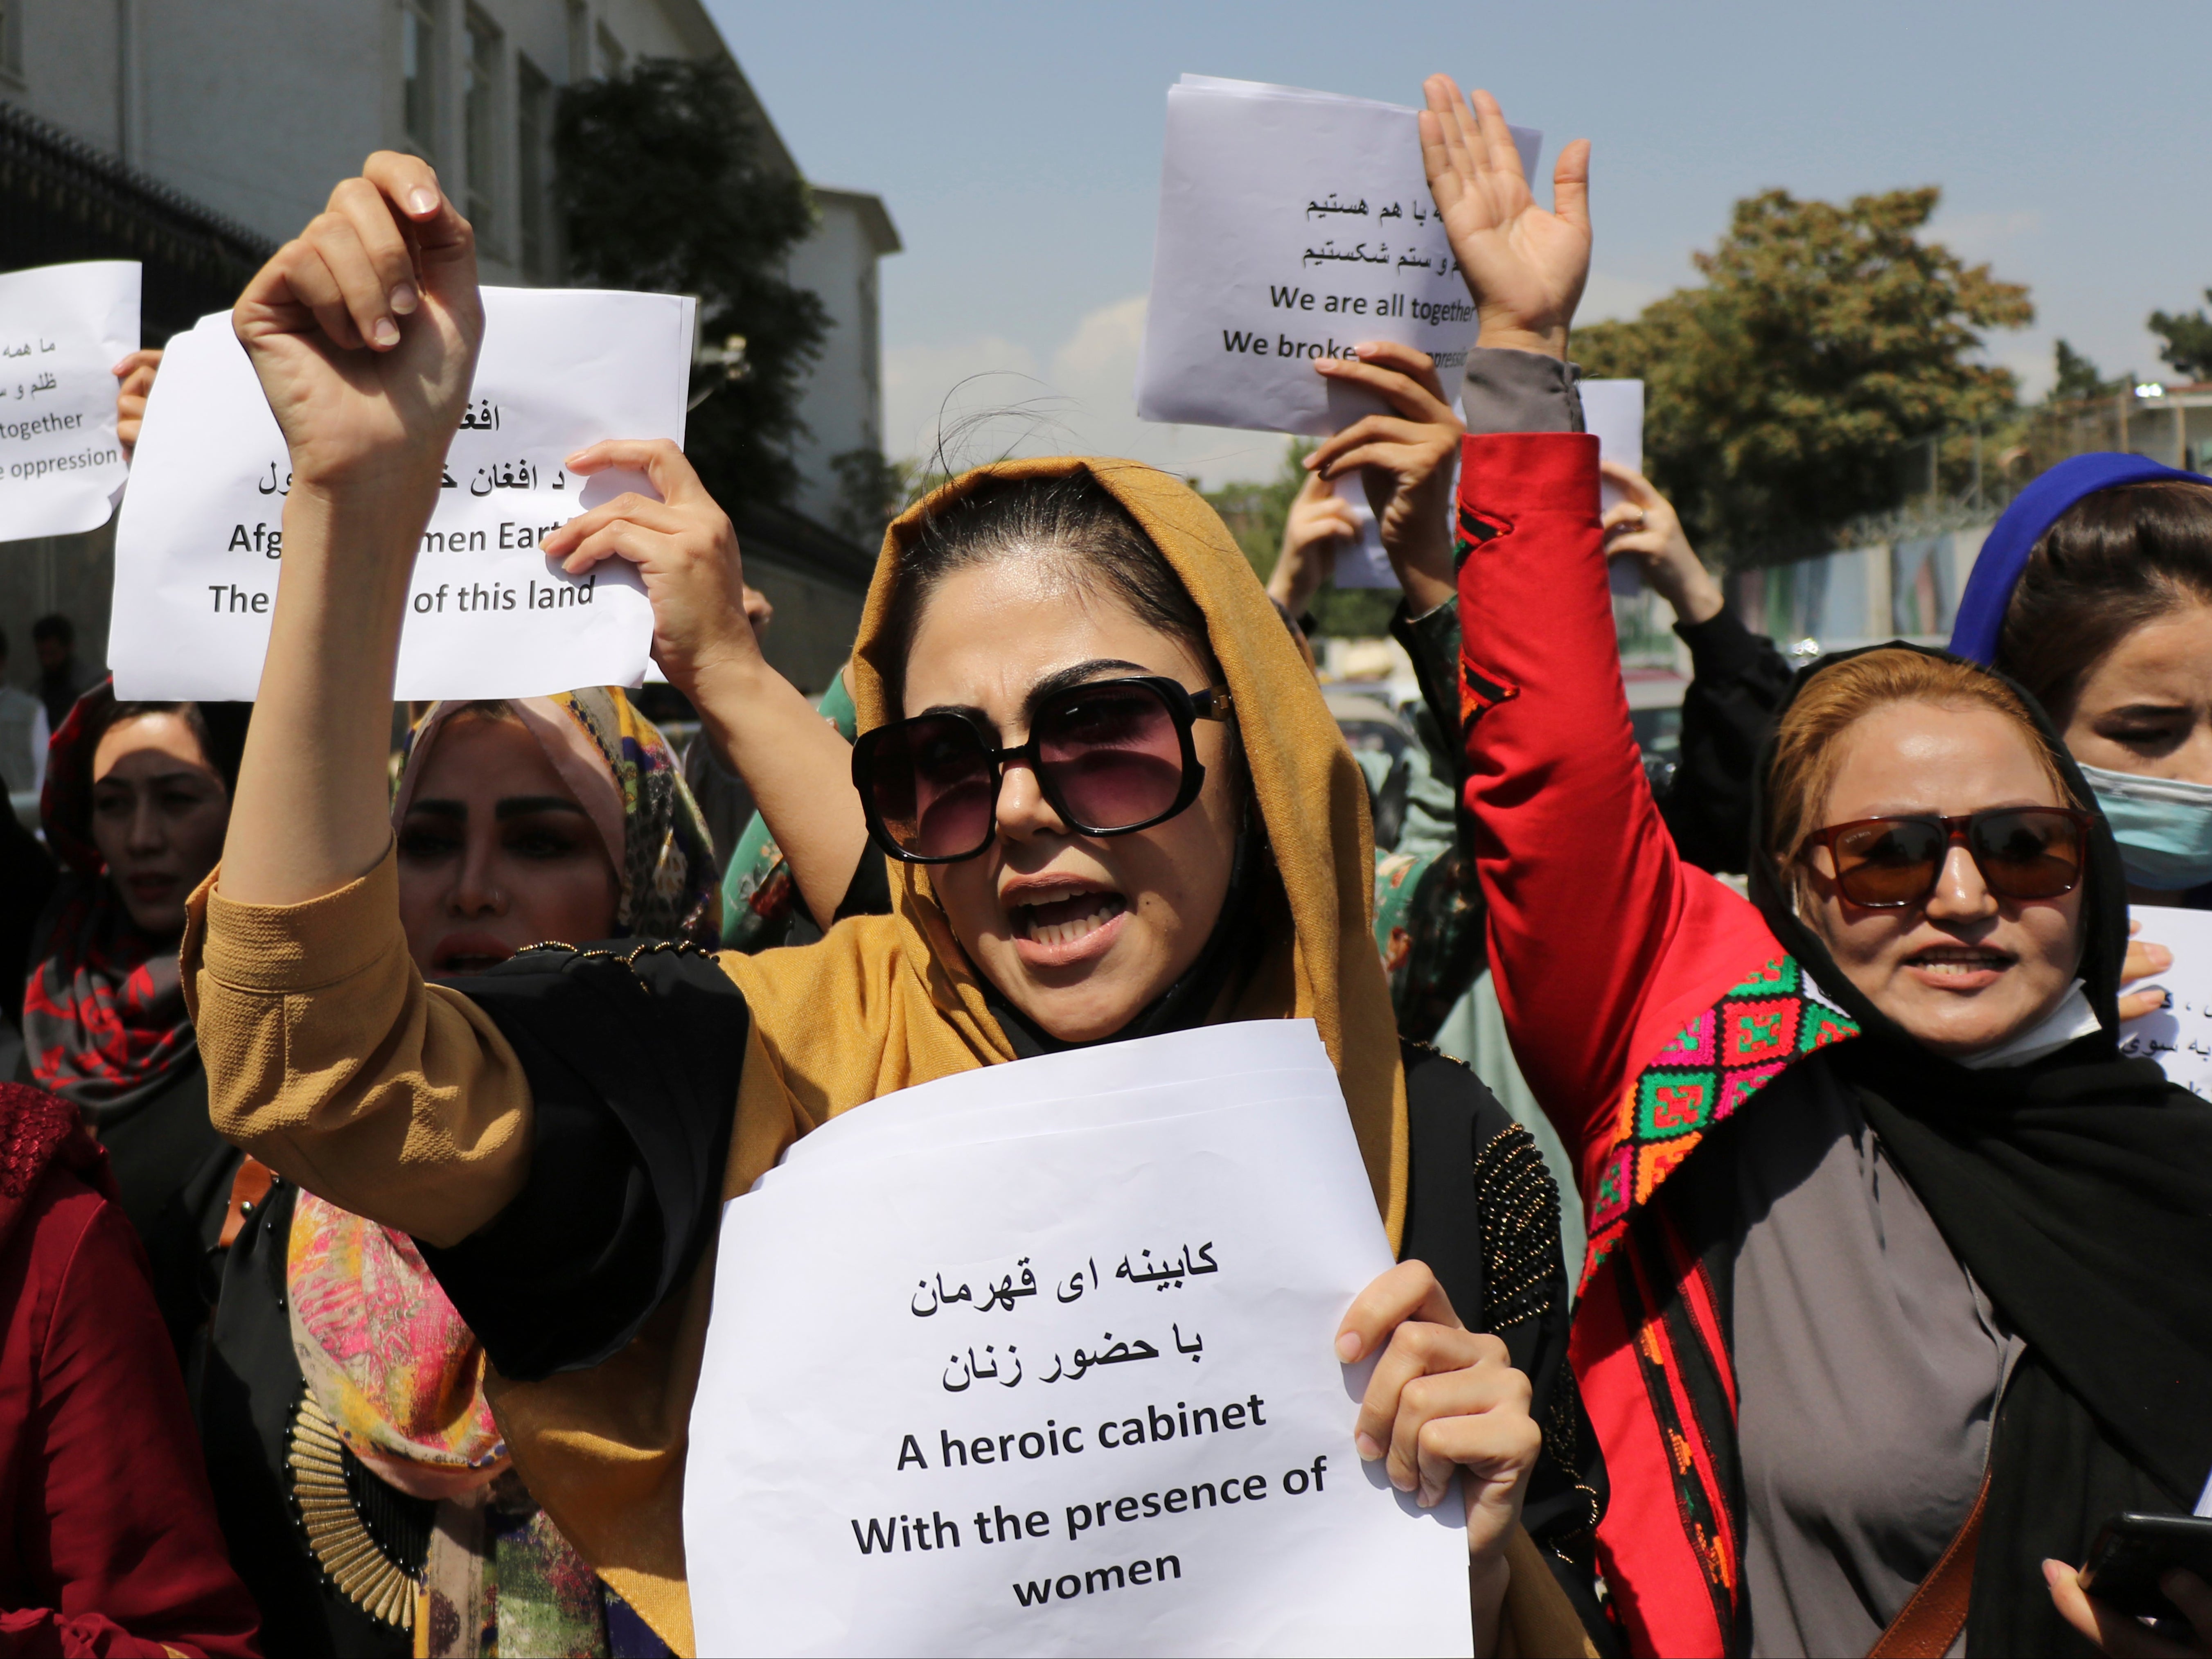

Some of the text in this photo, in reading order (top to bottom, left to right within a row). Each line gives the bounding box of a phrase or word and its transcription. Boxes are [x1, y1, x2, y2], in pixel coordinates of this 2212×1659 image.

[1306, 192, 1369, 221] هستیم
[1380, 201, 1403, 228] هم
[1413, 200, 1427, 227] با
[1302, 241, 1390, 268] شکستیم
[1397, 246, 1432, 276] ستم
[1436, 257, 1448, 277] و
[1270, 285, 1476, 327] We are all together
[2, 338, 56, 358] ما همه
[1223, 329, 1269, 356] We
[1277, 334, 1357, 362] broke
[14, 384, 25, 400] و
[30, 372, 57, 399] ظلم
[0, 412, 83, 441] together
[456, 399, 500, 431] افغ
[10, 447, 117, 480] oppression
[470, 459, 538, 497] افغان
[552, 470, 565, 490] د
[228, 522, 282, 560] Afg
[417, 530, 486, 553] men
[208, 575, 596, 614] The of this land
[911, 1241, 1218, 1317] کابینه ای قهرمان
[942, 1322, 1203, 1392] با حضور زنان
[897, 1394, 1267, 1471] A heroic cabinet
[851, 1455, 1328, 1555] With the presence of
[1013, 1555, 1182, 1607] women
